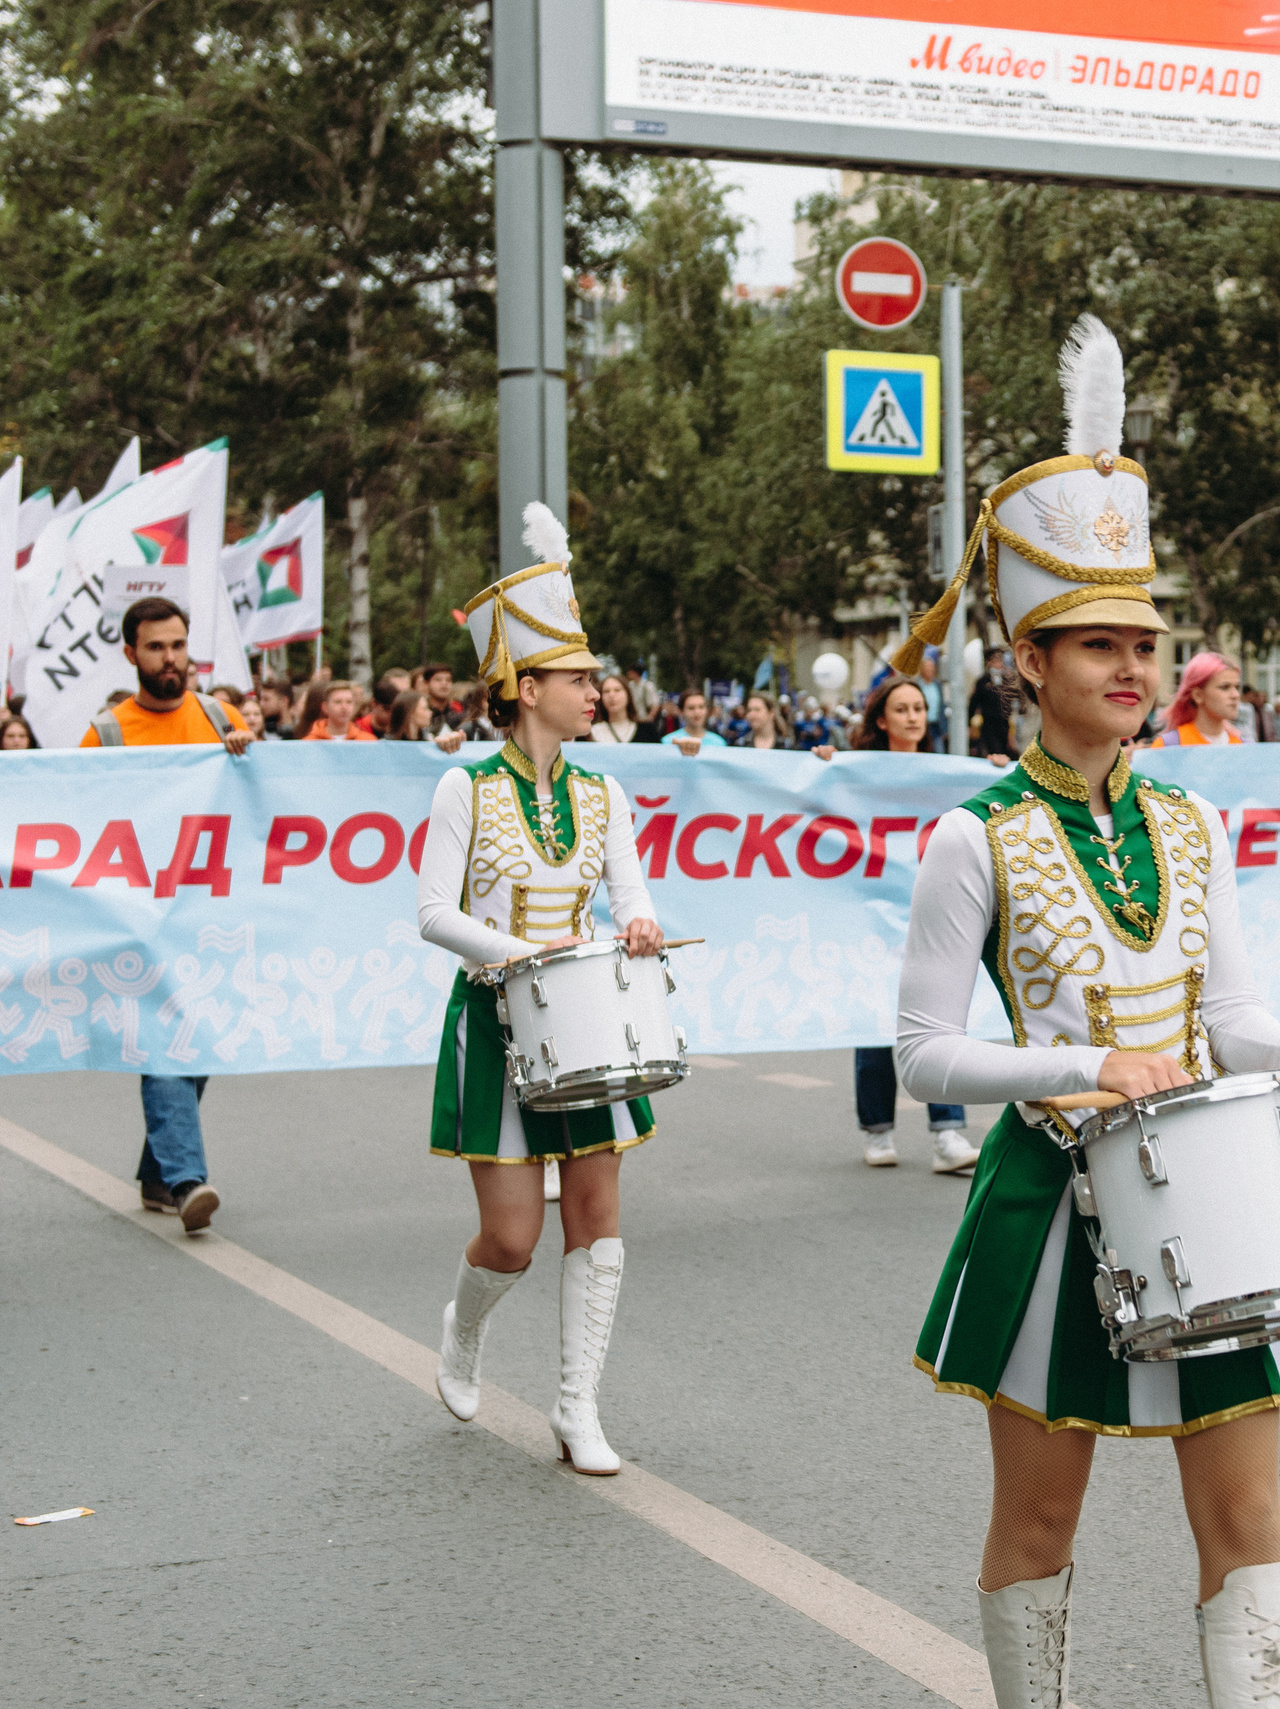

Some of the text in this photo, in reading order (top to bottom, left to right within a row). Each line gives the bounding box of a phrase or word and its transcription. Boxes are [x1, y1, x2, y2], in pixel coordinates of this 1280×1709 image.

[1068, 54, 1260, 99] ЭЛЬДОРАДО
[126, 581, 166, 592] НГТУ
[0, 812, 232, 899] РАД
